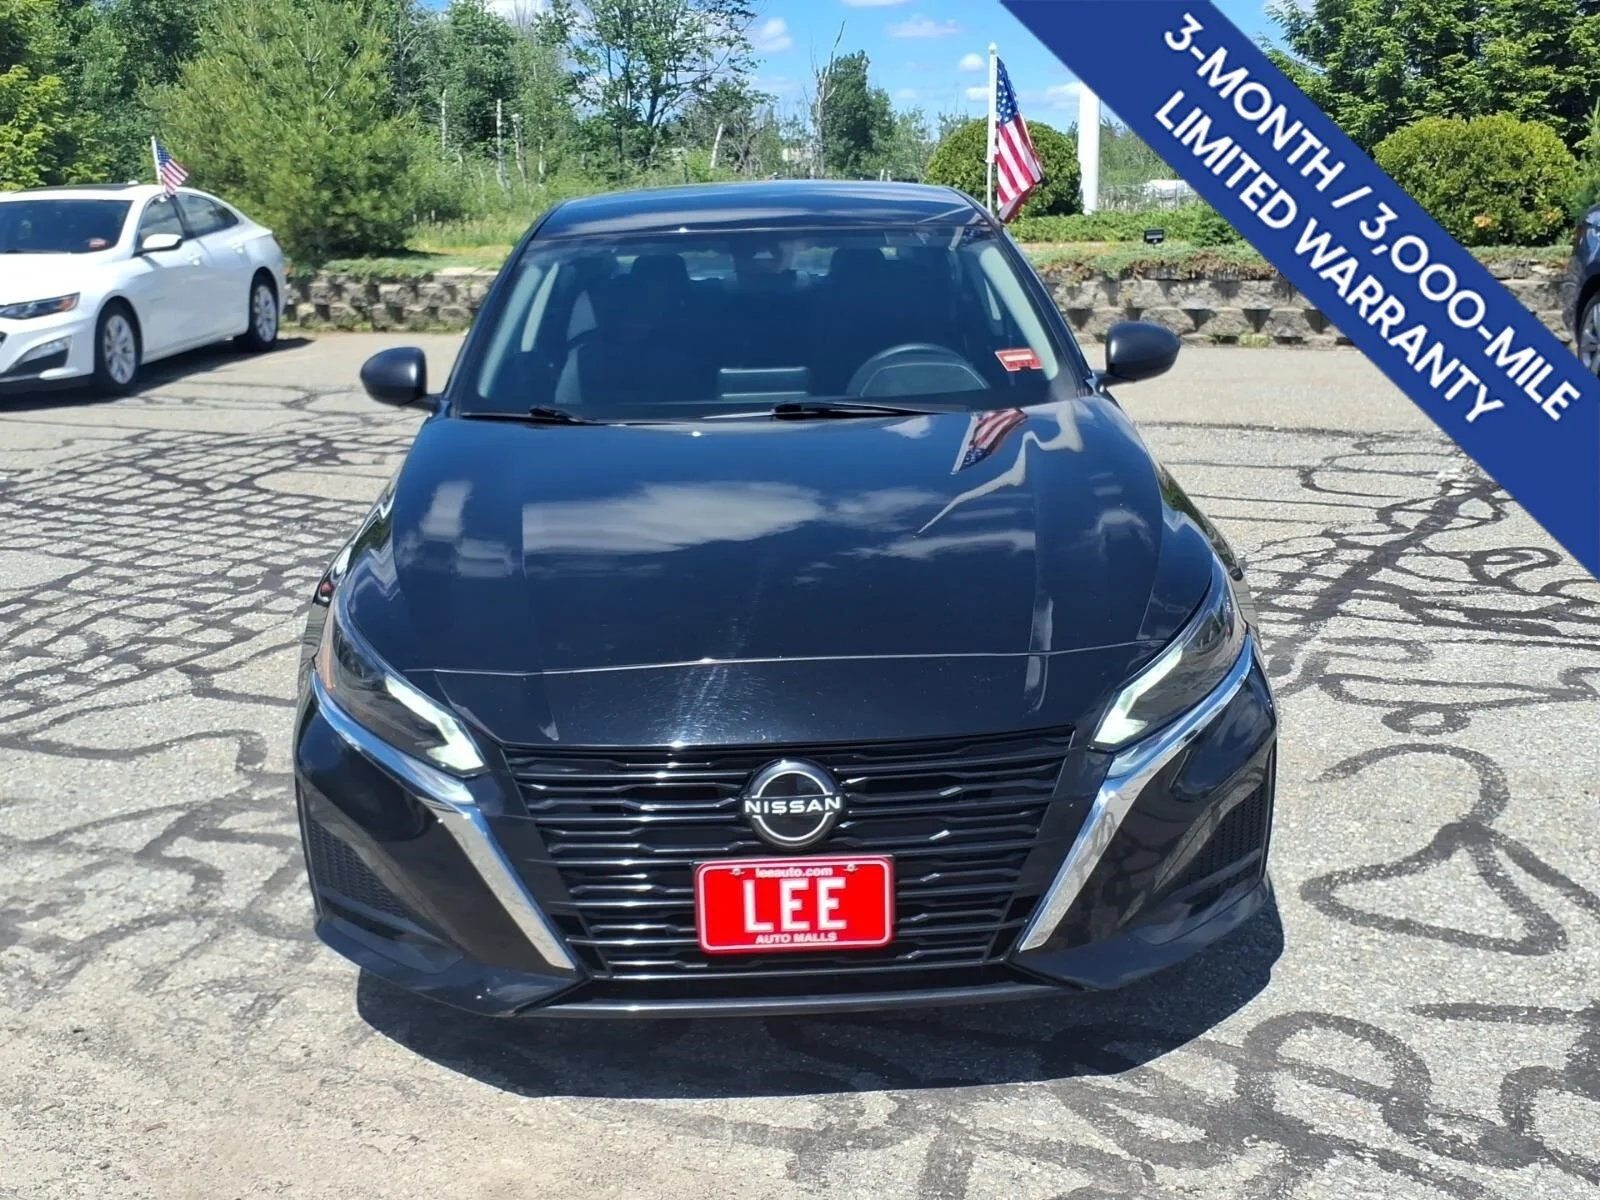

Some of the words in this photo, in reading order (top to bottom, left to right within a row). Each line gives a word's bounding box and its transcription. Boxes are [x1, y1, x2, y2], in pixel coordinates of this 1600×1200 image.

[744, 796, 841, 815] NISSAN
[755, 867, 833, 879] leeauto.com
[743, 877, 847, 933] LEE
[755, 933, 791, 944] AUTO
[793, 932, 838, 943] MALLS
